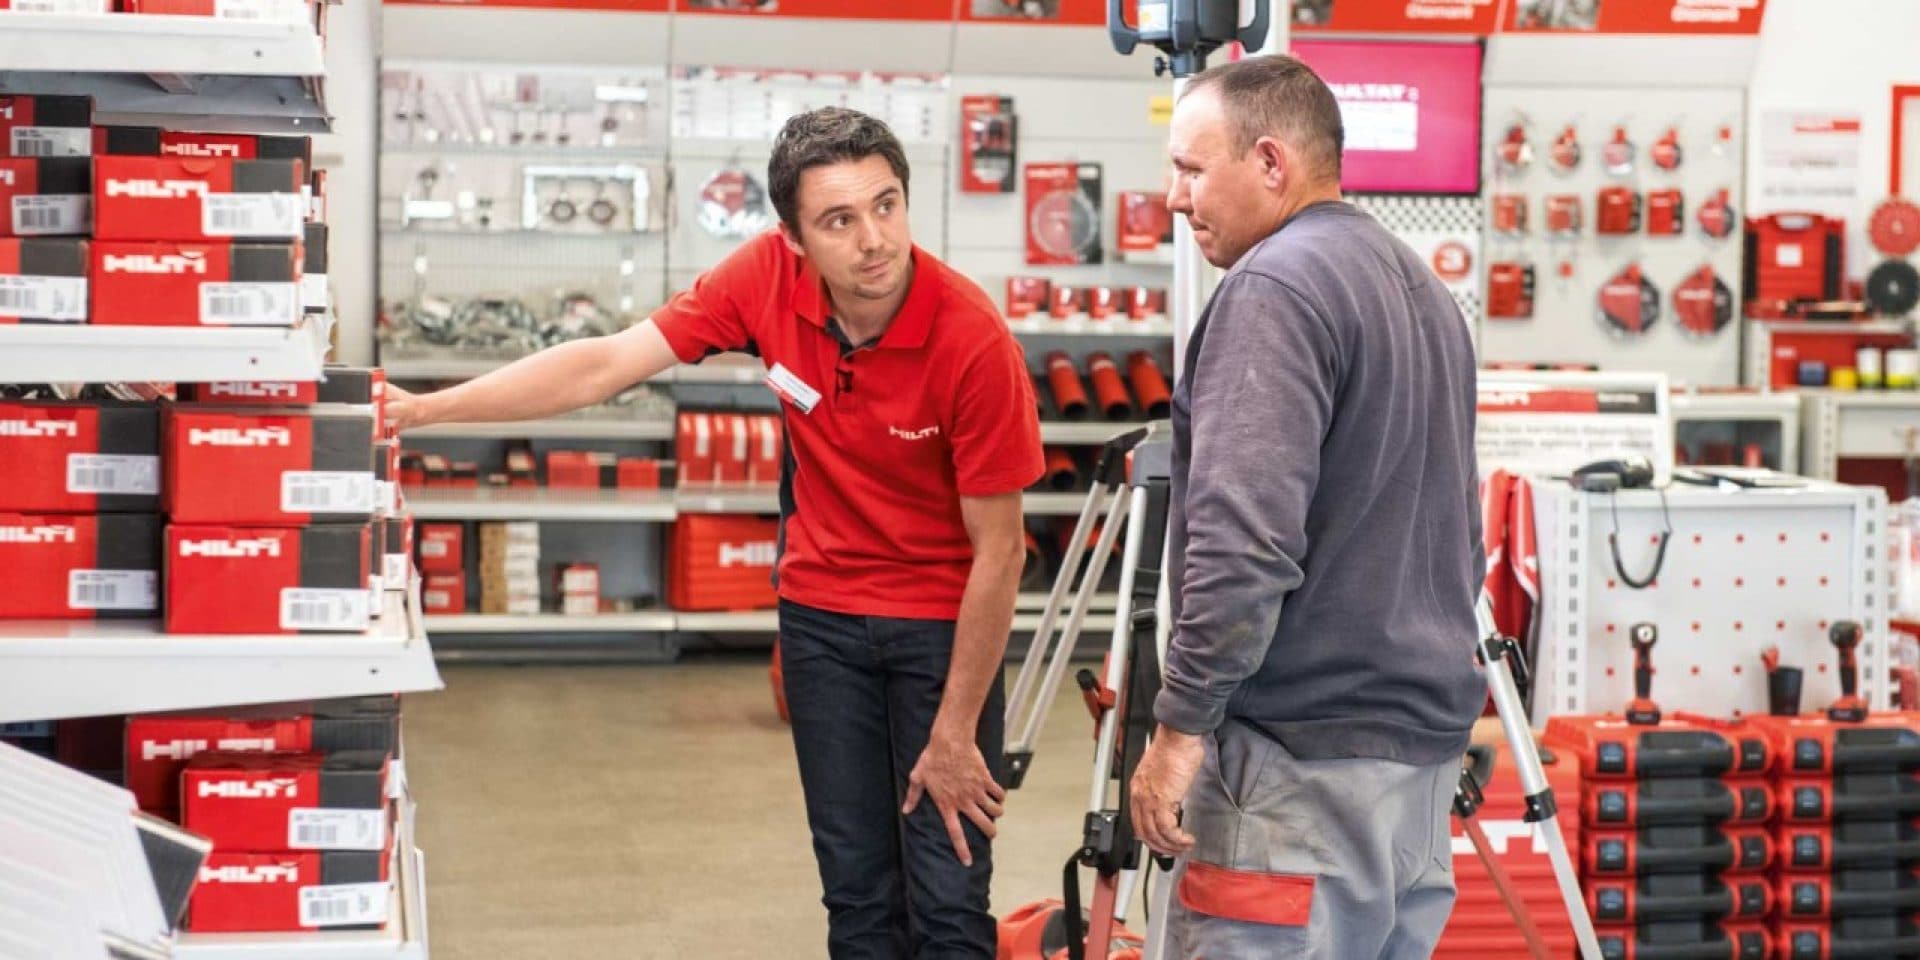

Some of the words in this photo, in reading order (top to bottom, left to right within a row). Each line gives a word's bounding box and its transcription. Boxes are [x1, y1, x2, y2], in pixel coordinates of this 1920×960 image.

[161, 143, 239, 157] HILTI
[107, 179, 209, 197] HILTI
[104, 254, 206, 273] HILTI
[210, 382, 297, 397] HILTI
[189, 427, 290, 446] HILTI
[889, 426, 939, 440] HILTI
[179, 538, 280, 556] HILTI
[198, 778, 298, 798] HILTI
[199, 864, 298, 883] HILTI
